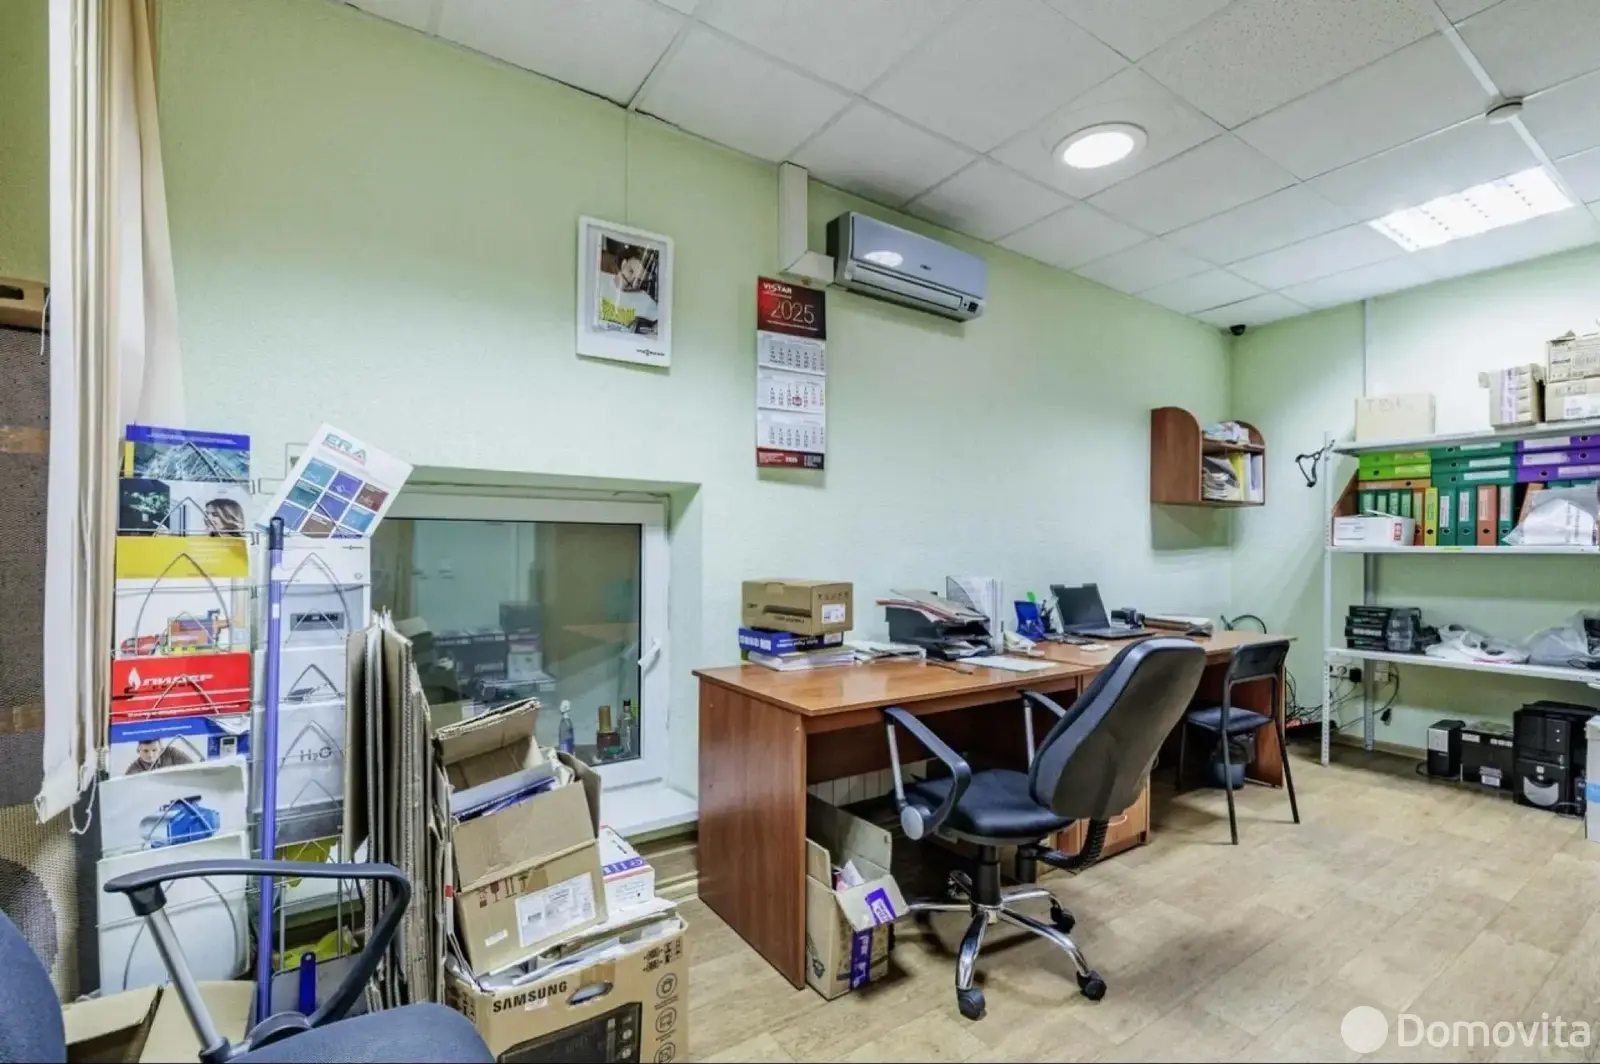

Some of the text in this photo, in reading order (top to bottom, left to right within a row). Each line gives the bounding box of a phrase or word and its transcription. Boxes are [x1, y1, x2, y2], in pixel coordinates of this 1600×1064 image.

[763, 282, 792, 294] VISTAR
[770, 299, 815, 325] 2025
[324, 432, 367, 463] ERA
[492, 980, 568, 1013] SAMSUNG
